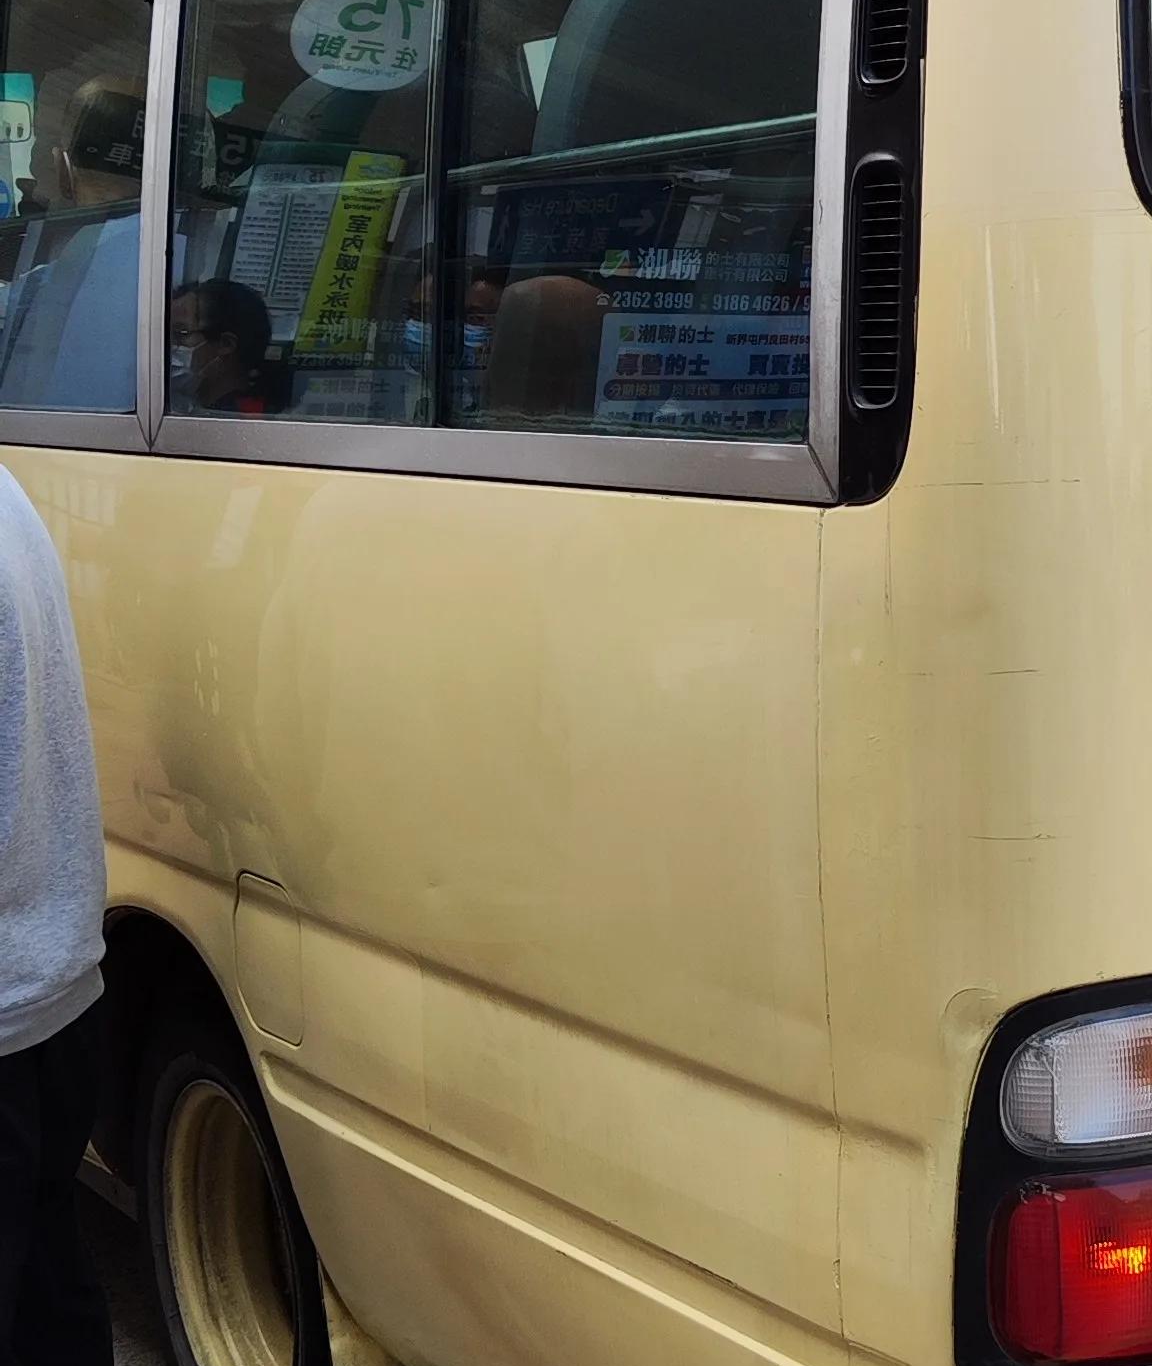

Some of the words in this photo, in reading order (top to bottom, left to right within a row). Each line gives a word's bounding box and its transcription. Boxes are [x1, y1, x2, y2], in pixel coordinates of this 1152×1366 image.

[612, 291, 652, 309] 2362
[654, 291, 694, 310] 3899
[712, 293, 750, 312] 9186
[753, 294, 790, 312] 4626
[638, 324, 714, 345] 潮聯的士
